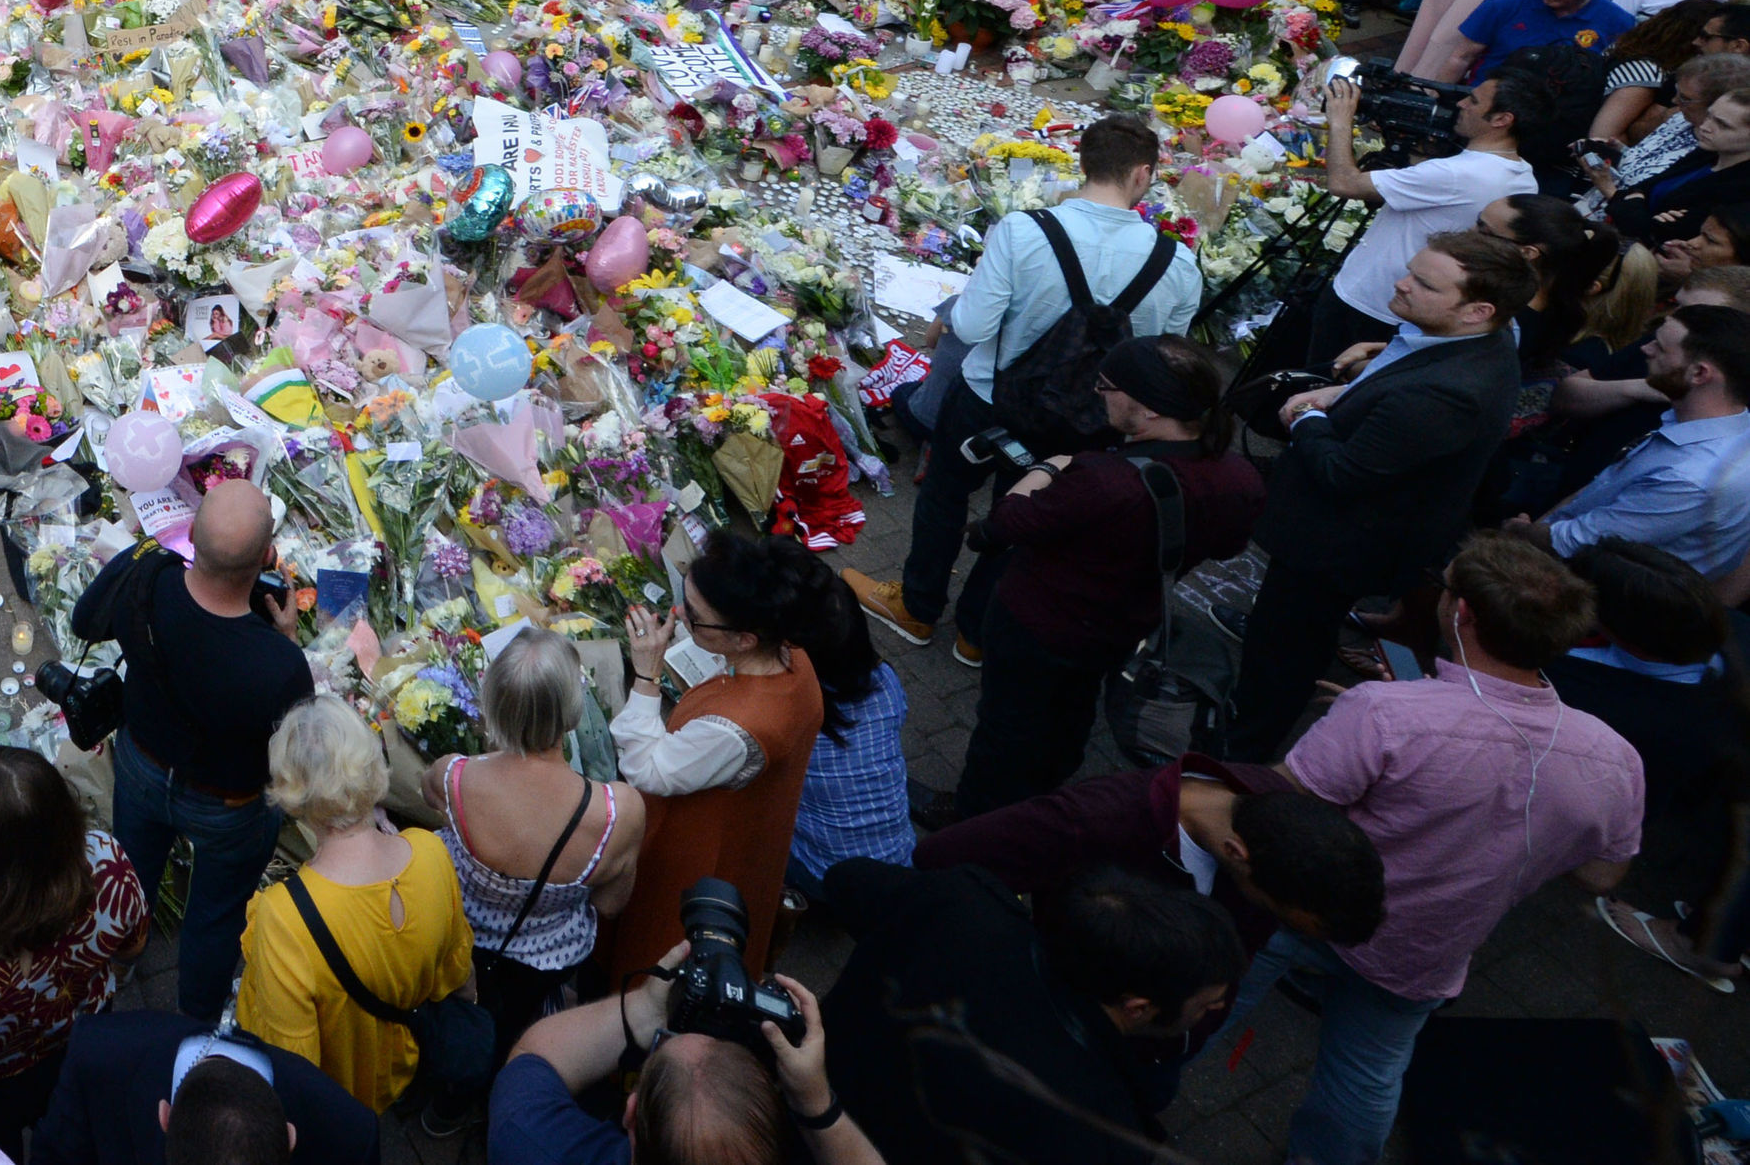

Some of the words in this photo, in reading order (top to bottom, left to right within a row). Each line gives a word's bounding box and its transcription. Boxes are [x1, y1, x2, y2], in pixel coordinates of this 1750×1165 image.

[111, 35, 132, 46] Rest
[149, 27, 185, 42] Paradise
[501, 137, 519, 172] ARE
[138, 498, 156, 512] YOU
[157, 496, 173, 505] ARE
[142, 507, 164, 521] HEARTS
